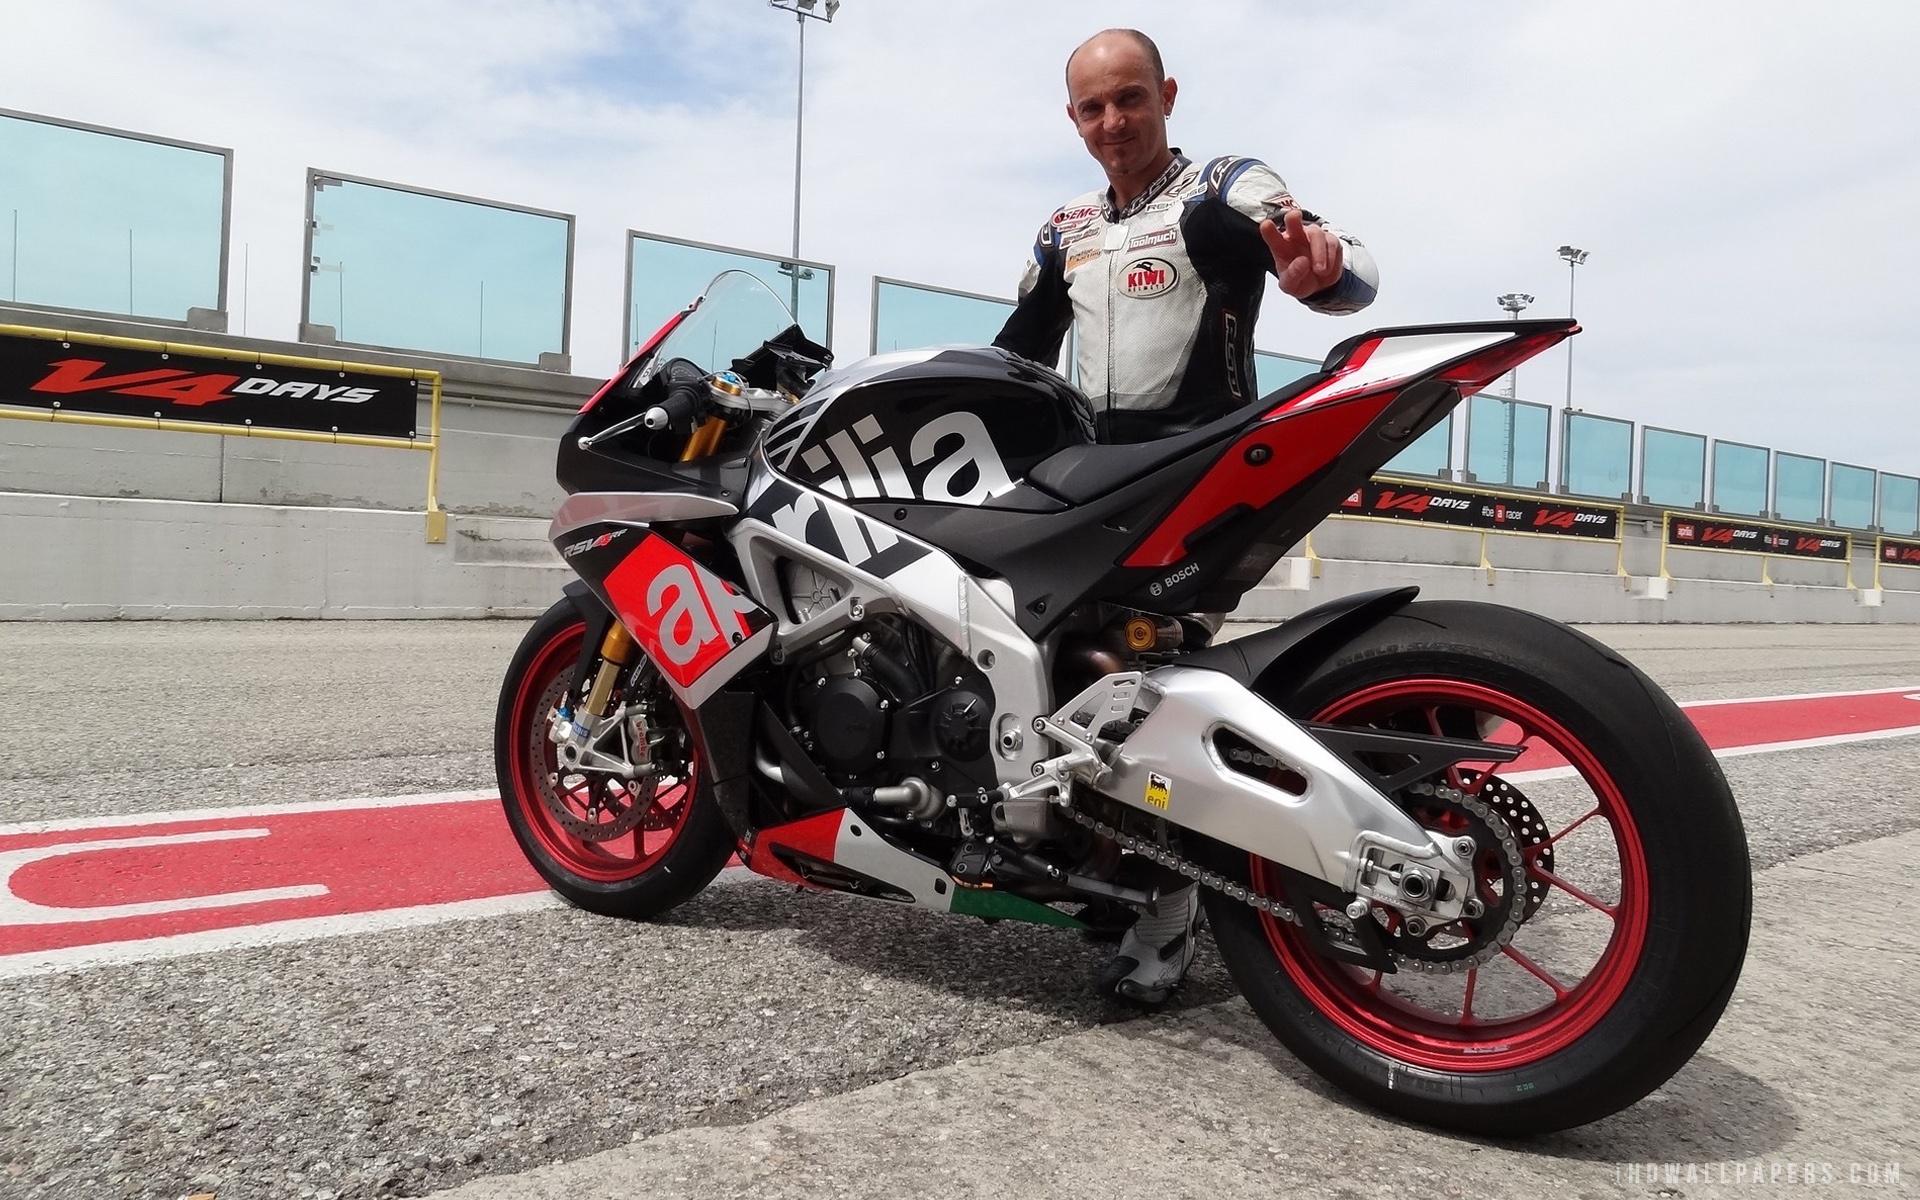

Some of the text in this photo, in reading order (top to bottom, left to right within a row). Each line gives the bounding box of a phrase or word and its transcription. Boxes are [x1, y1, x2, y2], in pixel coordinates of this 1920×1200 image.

[1127, 269, 1165, 288] KIWI
[30, 358, 381, 407] V4 DAYS
[1375, 491, 1433, 513] V4
[1429, 496, 1471, 510] DAYS
[1533, 509, 1608, 529] V4 DAYS
[1701, 527, 1735, 543] V4
[1733, 530, 1758, 539] DAYS
[1795, 537, 1821, 551] V4
[1819, 540, 1841, 548] DAYS
[1164, 562, 1200, 588] BOSCH
[1147, 795, 1166, 809] eni
